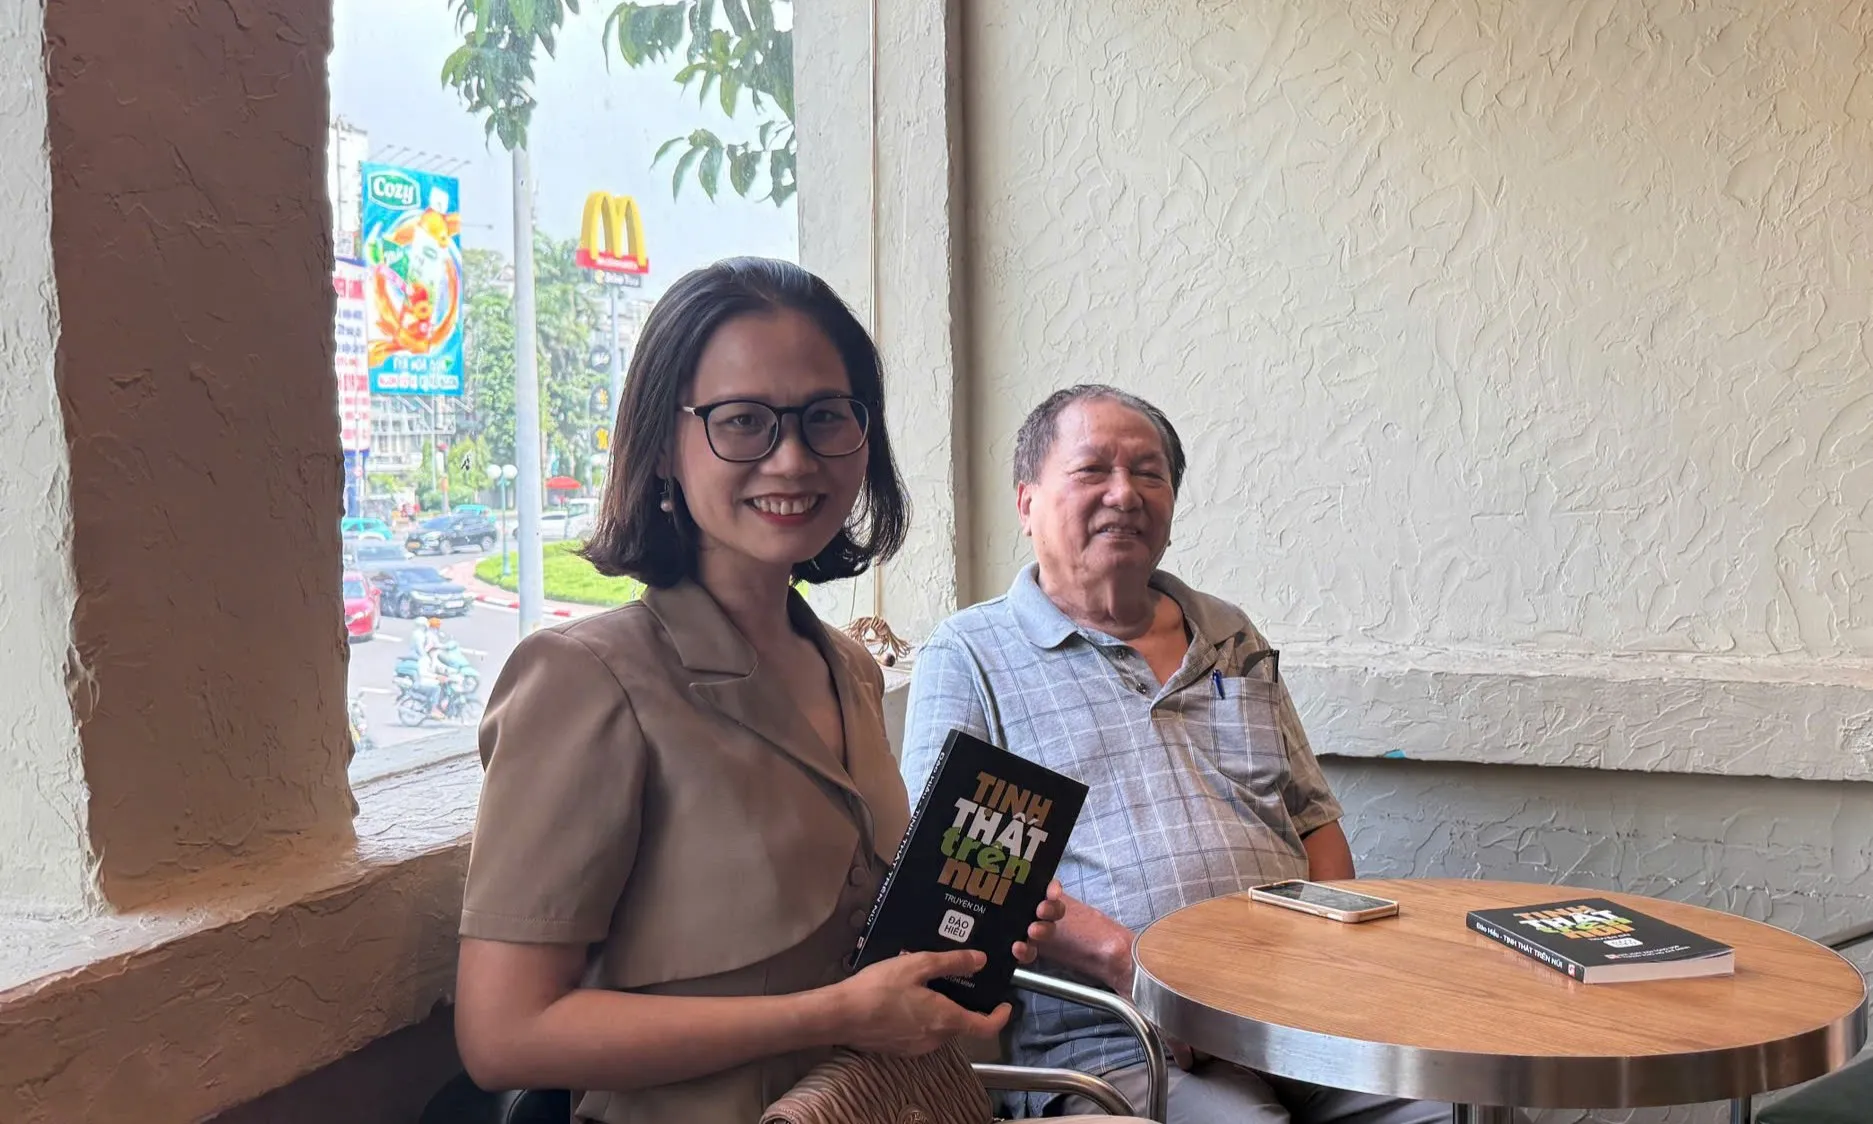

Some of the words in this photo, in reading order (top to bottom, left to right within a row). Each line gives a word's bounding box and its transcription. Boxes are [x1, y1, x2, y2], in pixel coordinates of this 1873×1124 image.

[373, 176, 414, 204] Cozy
[952, 797, 1049, 862] THẤT
[940, 826, 1032, 884] trên
[947, 914, 969, 930] ĐÀO
[1534, 948, 1551, 963] TRÊN
[1551, 957, 1563, 969] NÚI
